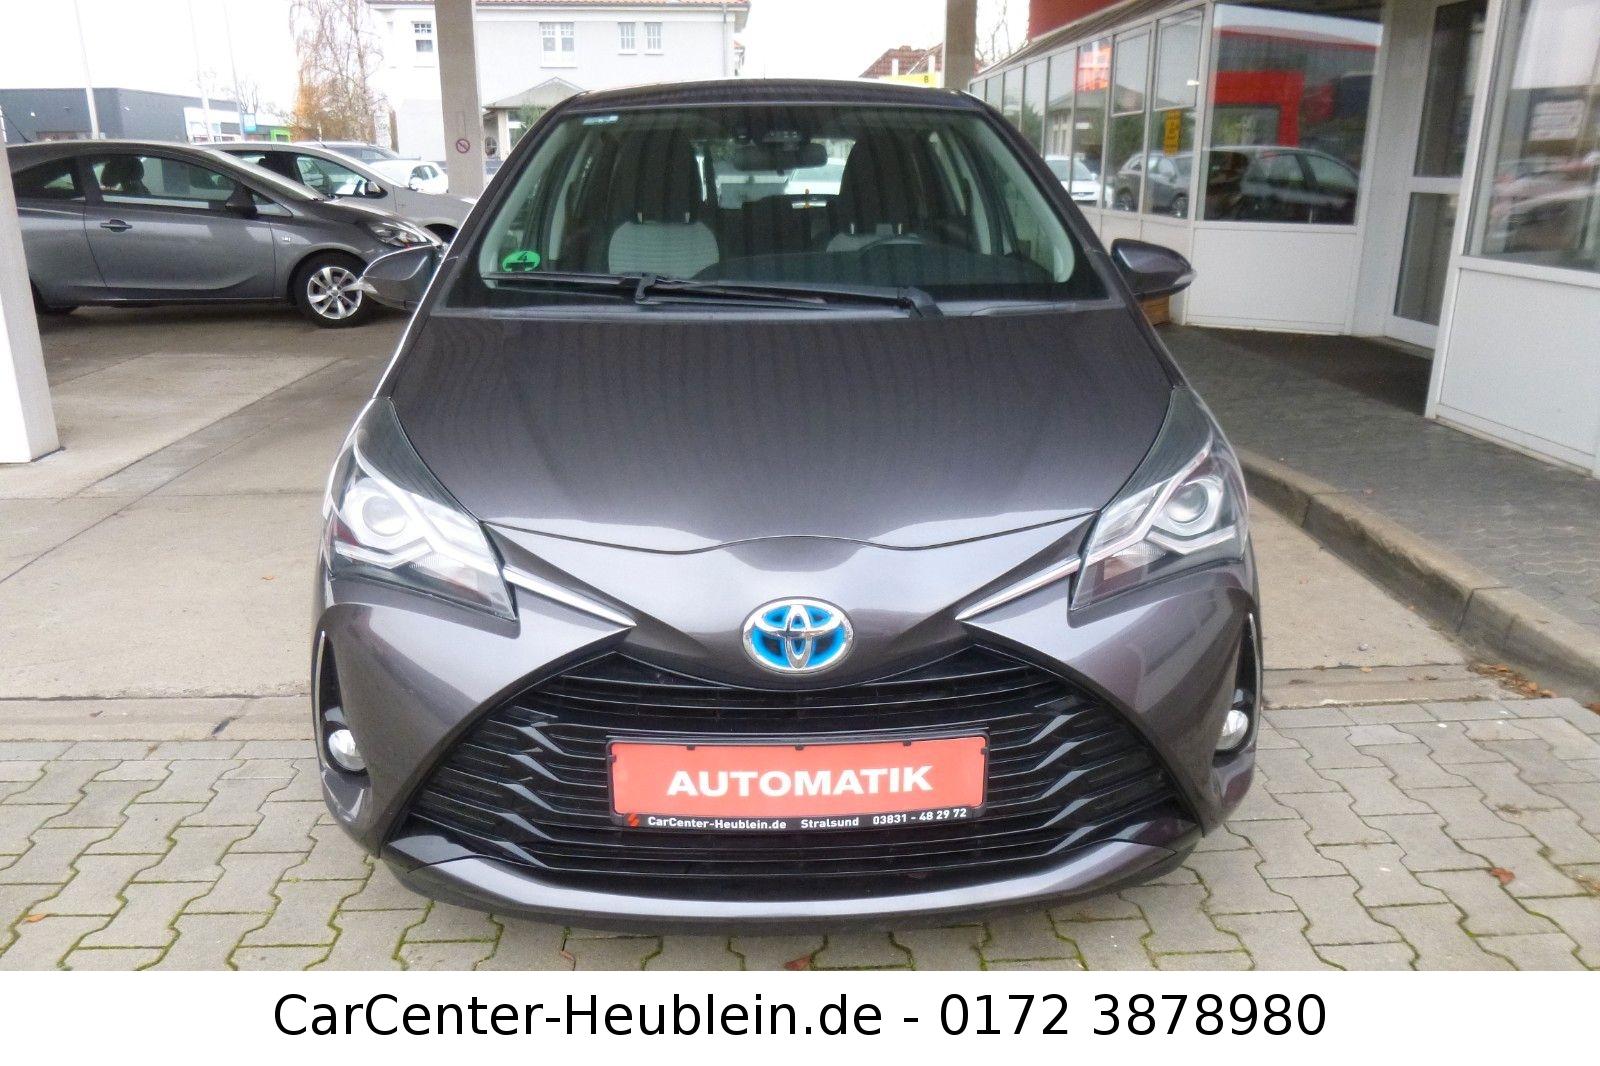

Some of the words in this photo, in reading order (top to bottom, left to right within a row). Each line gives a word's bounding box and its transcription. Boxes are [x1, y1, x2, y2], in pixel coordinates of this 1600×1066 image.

[667, 765, 933, 797] AUTOMATIK
[647, 816, 787, 829] CarCenter-Heublein.de
[800, 816, 860, 829] Stralsund
[873, 813, 907, 825] 03831
[919, 811, 934, 823] 48
[935, 809, 951, 822] 29
[952, 807, 967, 819] 72
